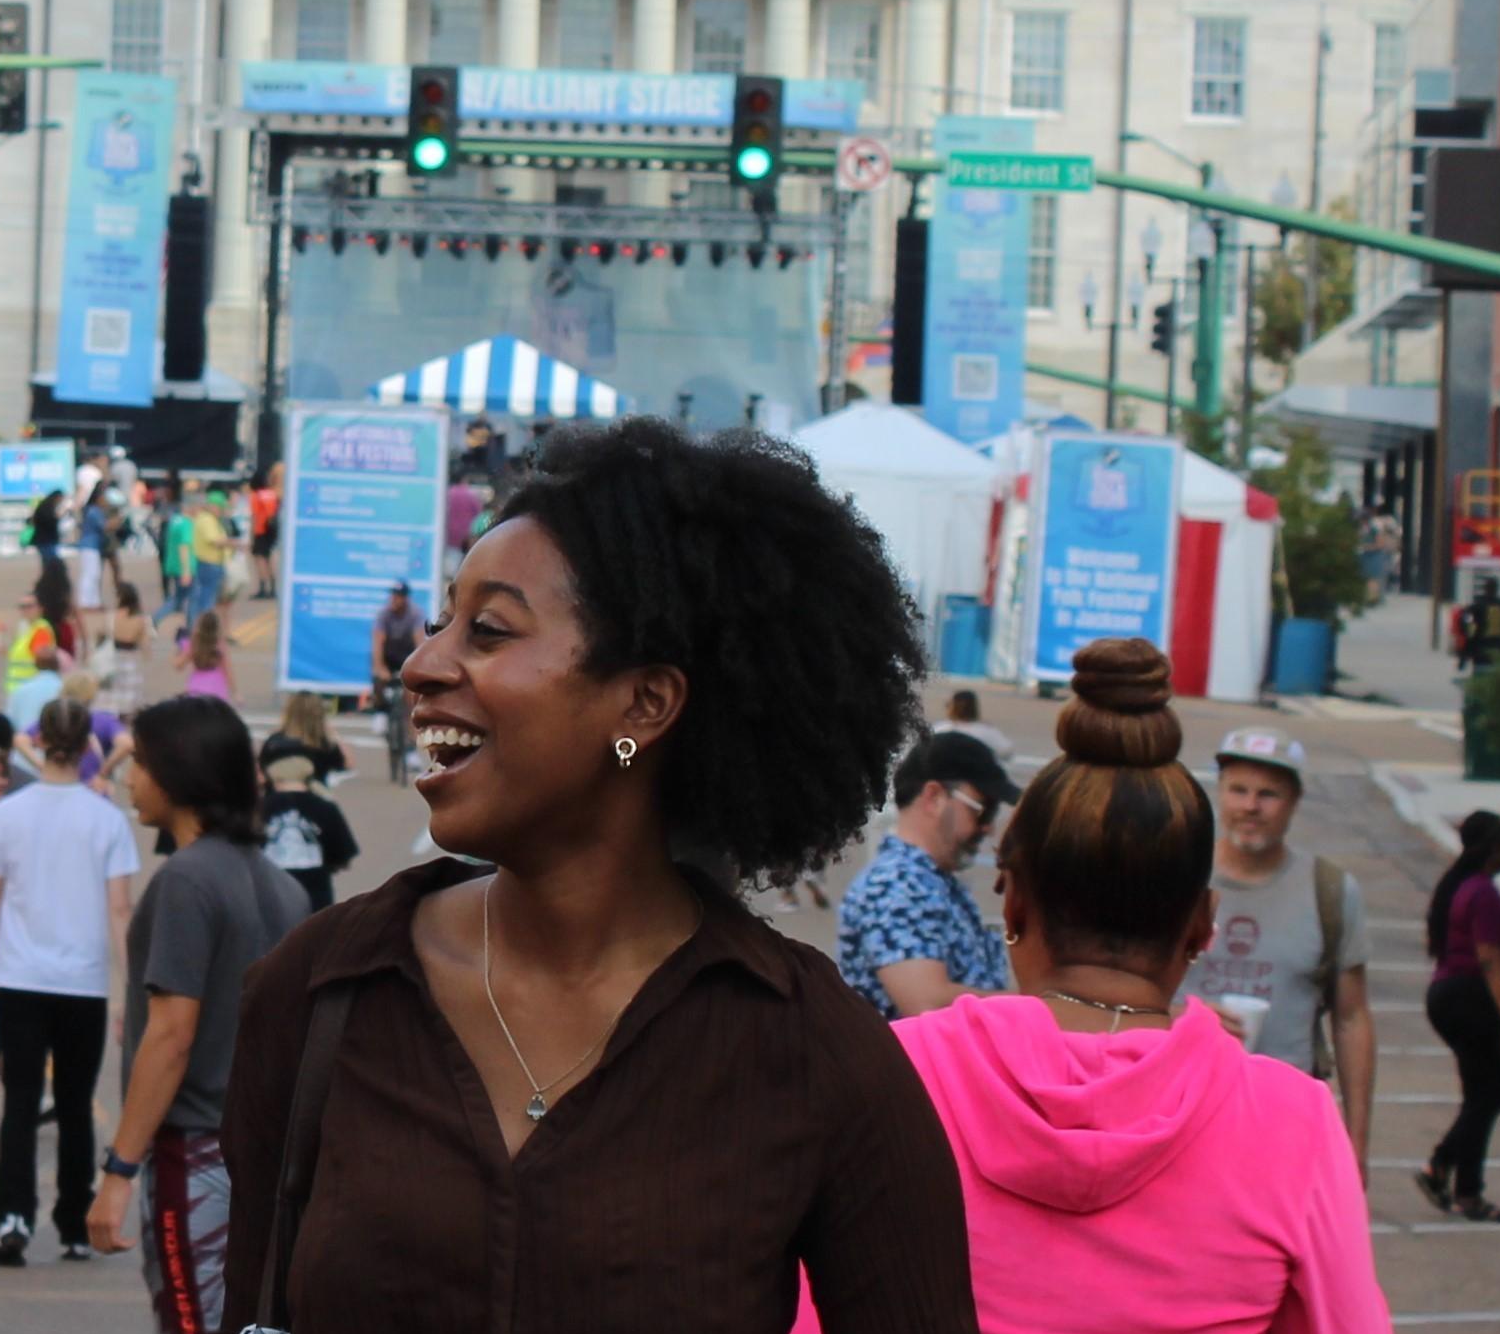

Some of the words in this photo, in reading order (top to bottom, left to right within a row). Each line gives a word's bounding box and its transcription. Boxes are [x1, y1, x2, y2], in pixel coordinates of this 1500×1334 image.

[628, 74, 722, 116] STAGE
[951, 157, 1060, 186] President
[1068, 160, 1090, 189] St
[1064, 568, 1091, 587] the
[1094, 570, 1160, 592] National
[1052, 587, 1084, 607] Folk
[1088, 588, 1151, 612] Festival
[1074, 610, 1144, 632] Jackson
[1203, 960, 1274, 980] KEEP
[1202, 979, 1273, 998] CALM
